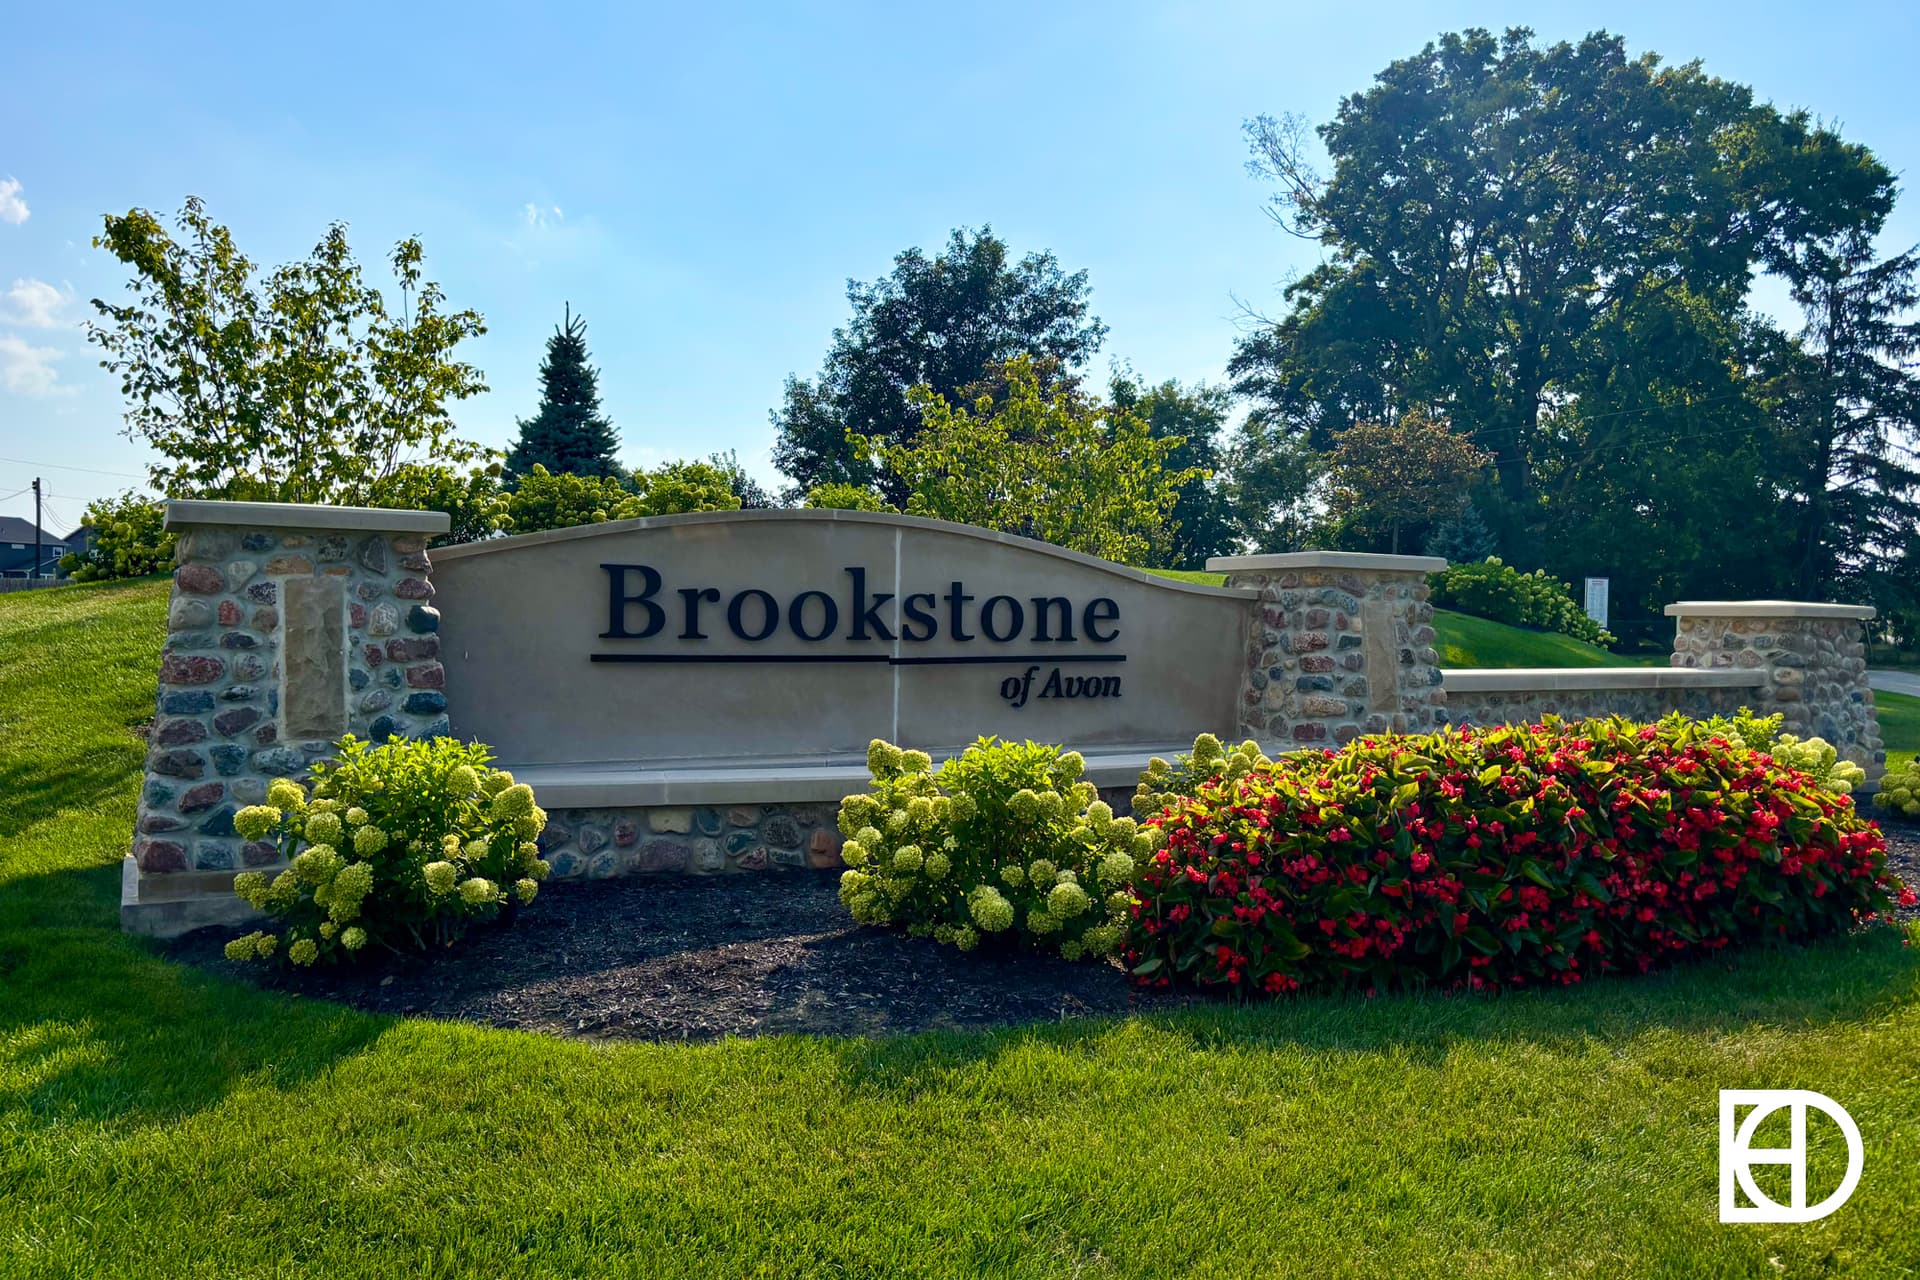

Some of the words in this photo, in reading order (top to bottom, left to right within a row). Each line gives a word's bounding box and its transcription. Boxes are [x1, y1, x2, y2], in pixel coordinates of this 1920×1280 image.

[598, 563, 1121, 644] Brookstone
[1000, 666, 1041, 708] of
[1037, 668, 1122, 699] Avon
